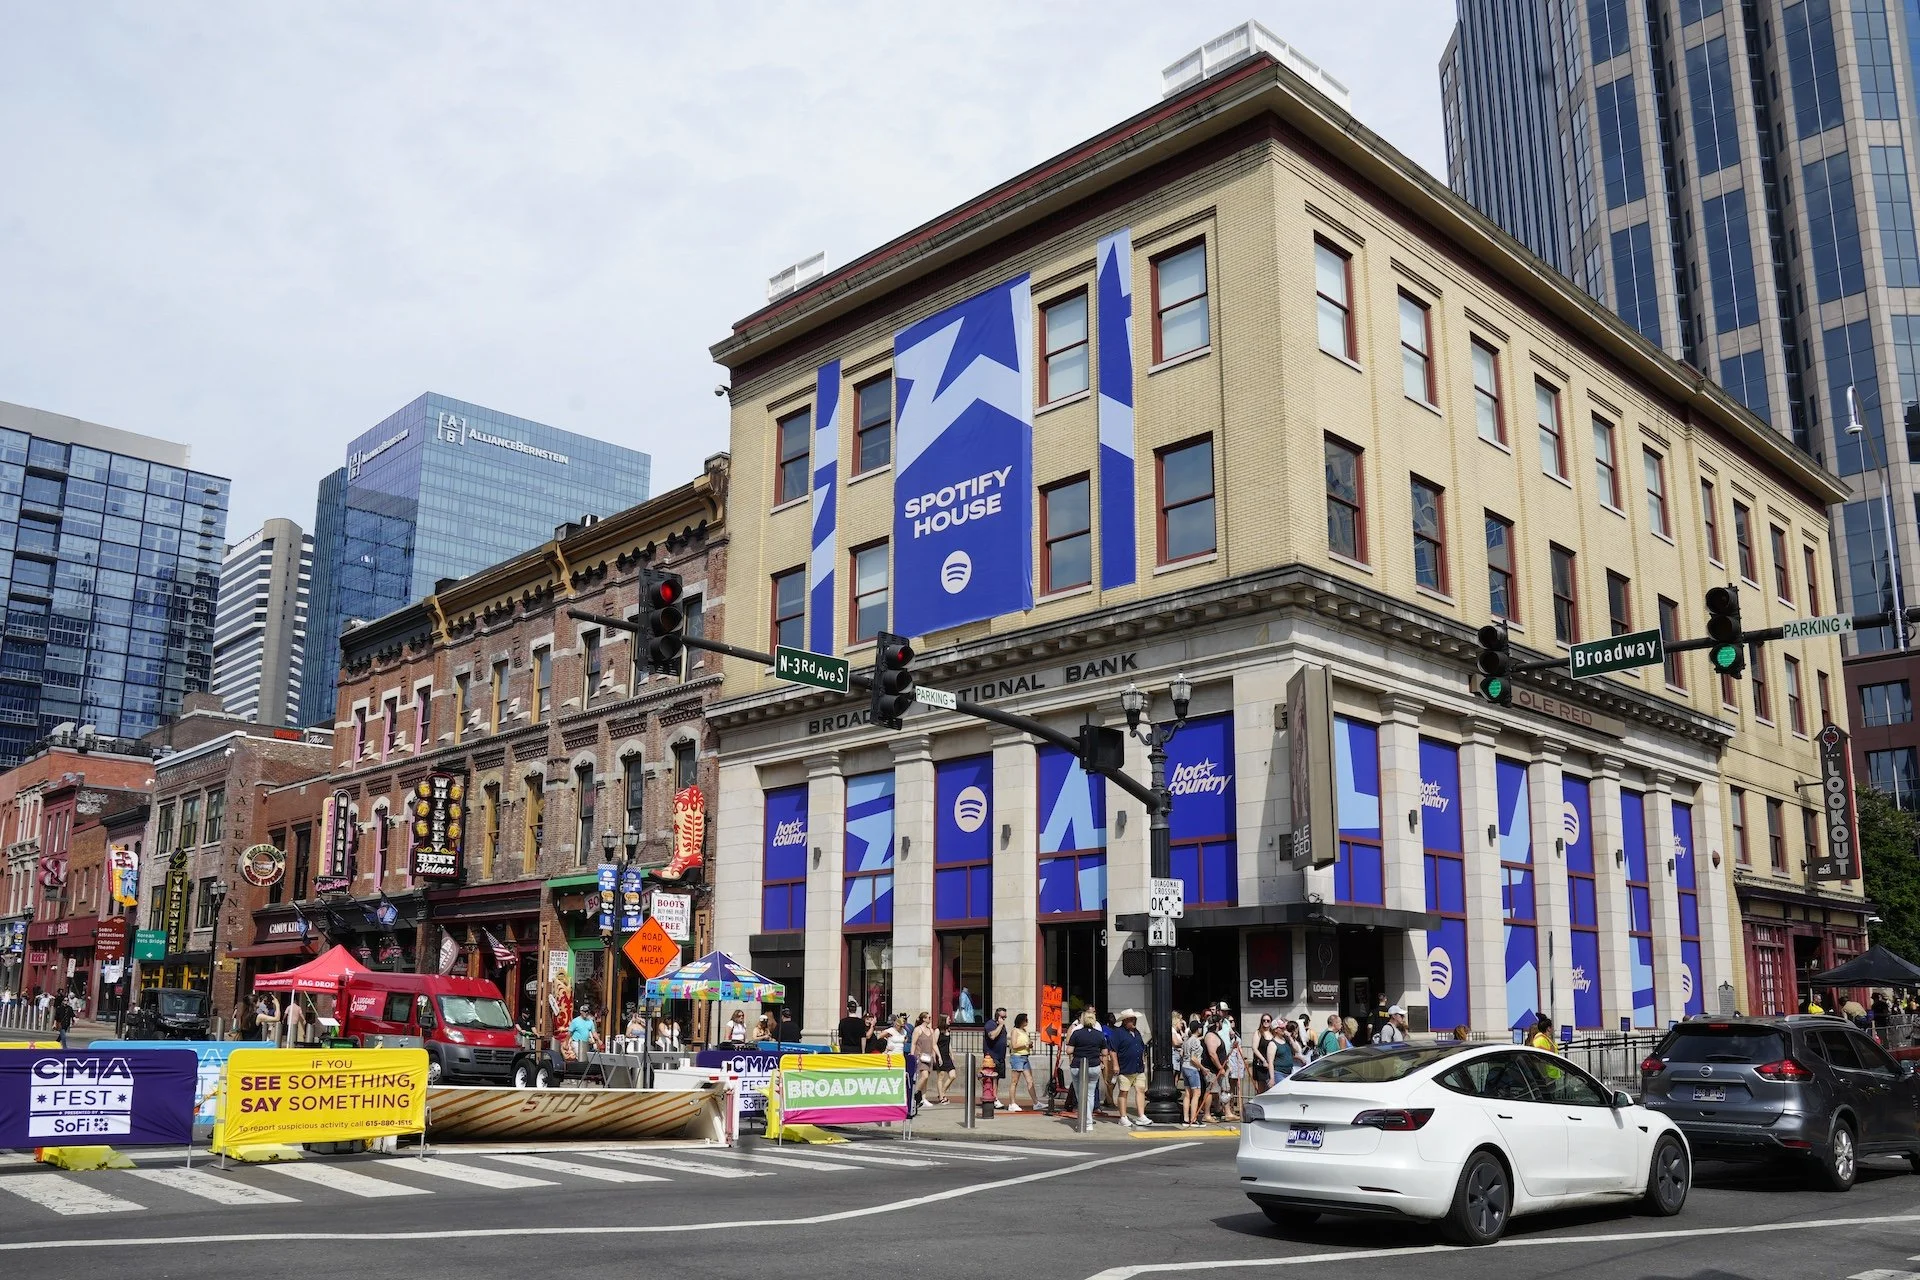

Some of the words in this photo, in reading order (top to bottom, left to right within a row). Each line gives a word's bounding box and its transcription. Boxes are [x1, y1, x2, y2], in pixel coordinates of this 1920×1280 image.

[904, 464, 1013, 519] SPOTIFY
[913, 492, 1002, 539] HOUSE
[1783, 618, 1840, 638] PARKING
[1575, 639, 1657, 669] Broadway
[816, 668, 836, 682] Ave
[836, 666, 844, 684] S
[958, 674, 1046, 702] TIONAL
[1065, 652, 1138, 684] BANK
[916, 688, 949, 706] PARKING
[1519, 690, 1554, 715] OLE
[1559, 704, 1593, 726] RED
[1172, 761, 1202, 783] hot
[1168, 774, 1233, 796] country
[1420, 793, 1450, 813] ountry
[431, 777, 449, 853] WHISKEY
[1826, 760, 1850, 876] LOOKOUT
[334, 796, 348, 873] MIRANDA
[775, 820, 795, 836] hot
[1293, 824, 1310, 844] OLE
[227, 778, 249, 926] VALENTINE
[1293, 838, 1311, 859] RED
[416, 853, 456, 865] BENT
[416, 862, 455, 875] Saloon
[1154, 879, 1180, 888] DIAGONAL
[1154, 887, 1180, 896] CROSSING
[657, 899, 685, 908] BOOTS
[1151, 897, 1164, 911] OK
[168, 875, 184, 953] VALENTINE
[269, 922, 288, 934] CANDY
[660, 922, 681, 930] FREE
[642, 932, 663, 941] ROAD
[641, 945, 662, 953] WORK
[639, 956, 665, 965] AHEAD
[298, 979, 314, 987] BAG
[314, 980, 336, 988] DROP
[1249, 978, 1288, 989] OLE
[1250, 987, 1289, 998] RED
[1312, 984, 1339, 993] LOOKOUT
[357, 996, 376, 1005] LUGGAGE
[31, 1057, 132, 1080] CMA
[311, 1060, 323, 1069] IF
[327, 1060, 353, 1069] YOU
[731, 1055, 778, 1073] CMA
[240, 1076, 281, 1091] SEE
[288, 1074, 416, 1091] SOMETHING,
[787, 1077, 903, 1099] BROADWAY
[53, 1090, 112, 1106] FEST
[240, 1096, 283, 1113] SAY
[288, 1093, 410, 1111] SOMETHING
[520, 1093, 598, 1113] STOP
[54, 1118, 91, 1133] SoFi
[239, 1125, 249, 1133] To
[250, 1124, 276, 1133] report
[277, 1122, 319, 1131] suspicious
[320, 1120, 350, 1130] activity
[350, 1120, 364, 1128] call
[365, 1119, 413, 1128] 615-880-1515
